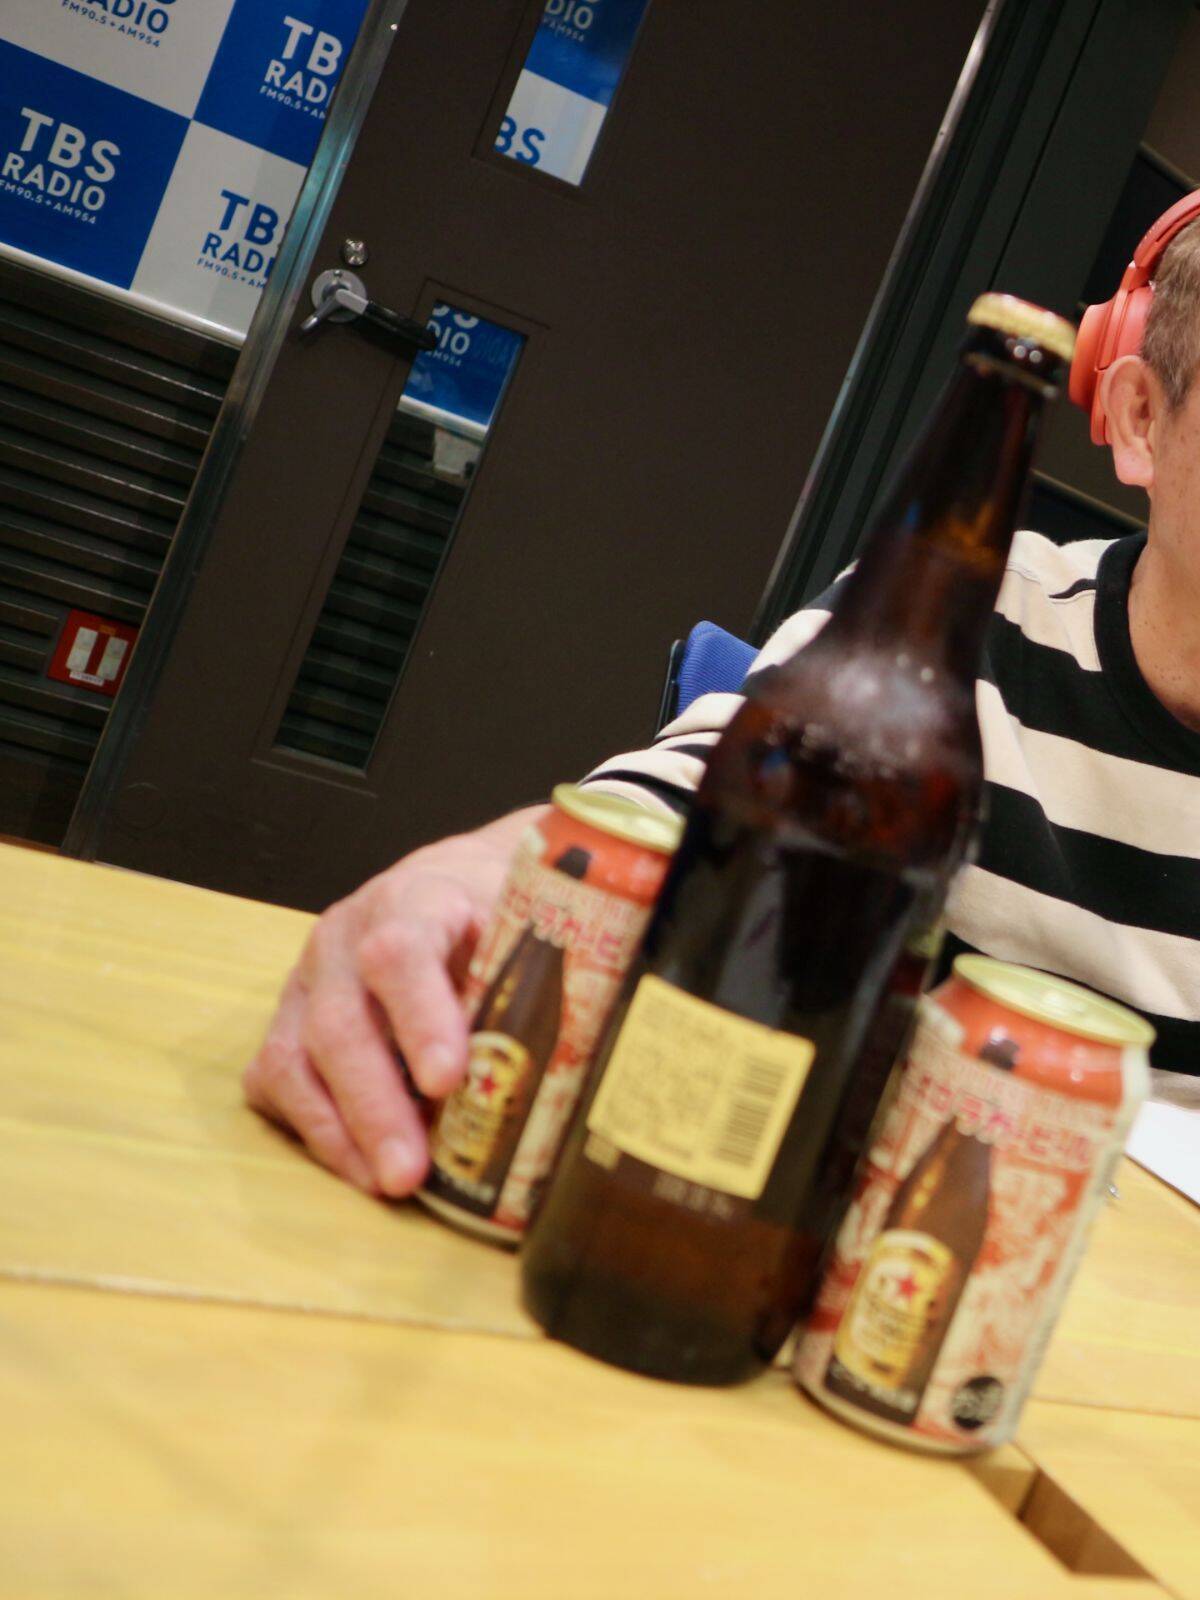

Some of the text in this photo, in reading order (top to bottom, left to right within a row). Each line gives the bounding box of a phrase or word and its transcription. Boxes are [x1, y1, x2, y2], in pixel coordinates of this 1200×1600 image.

[281, 15, 343, 77] TB
[21, 106, 122, 183] TBS
[494, 115, 546, 167] BS
[1, 152, 107, 212] RADIO
[220, 188, 280, 246] TB
[201, 231, 277, 279] RADI
